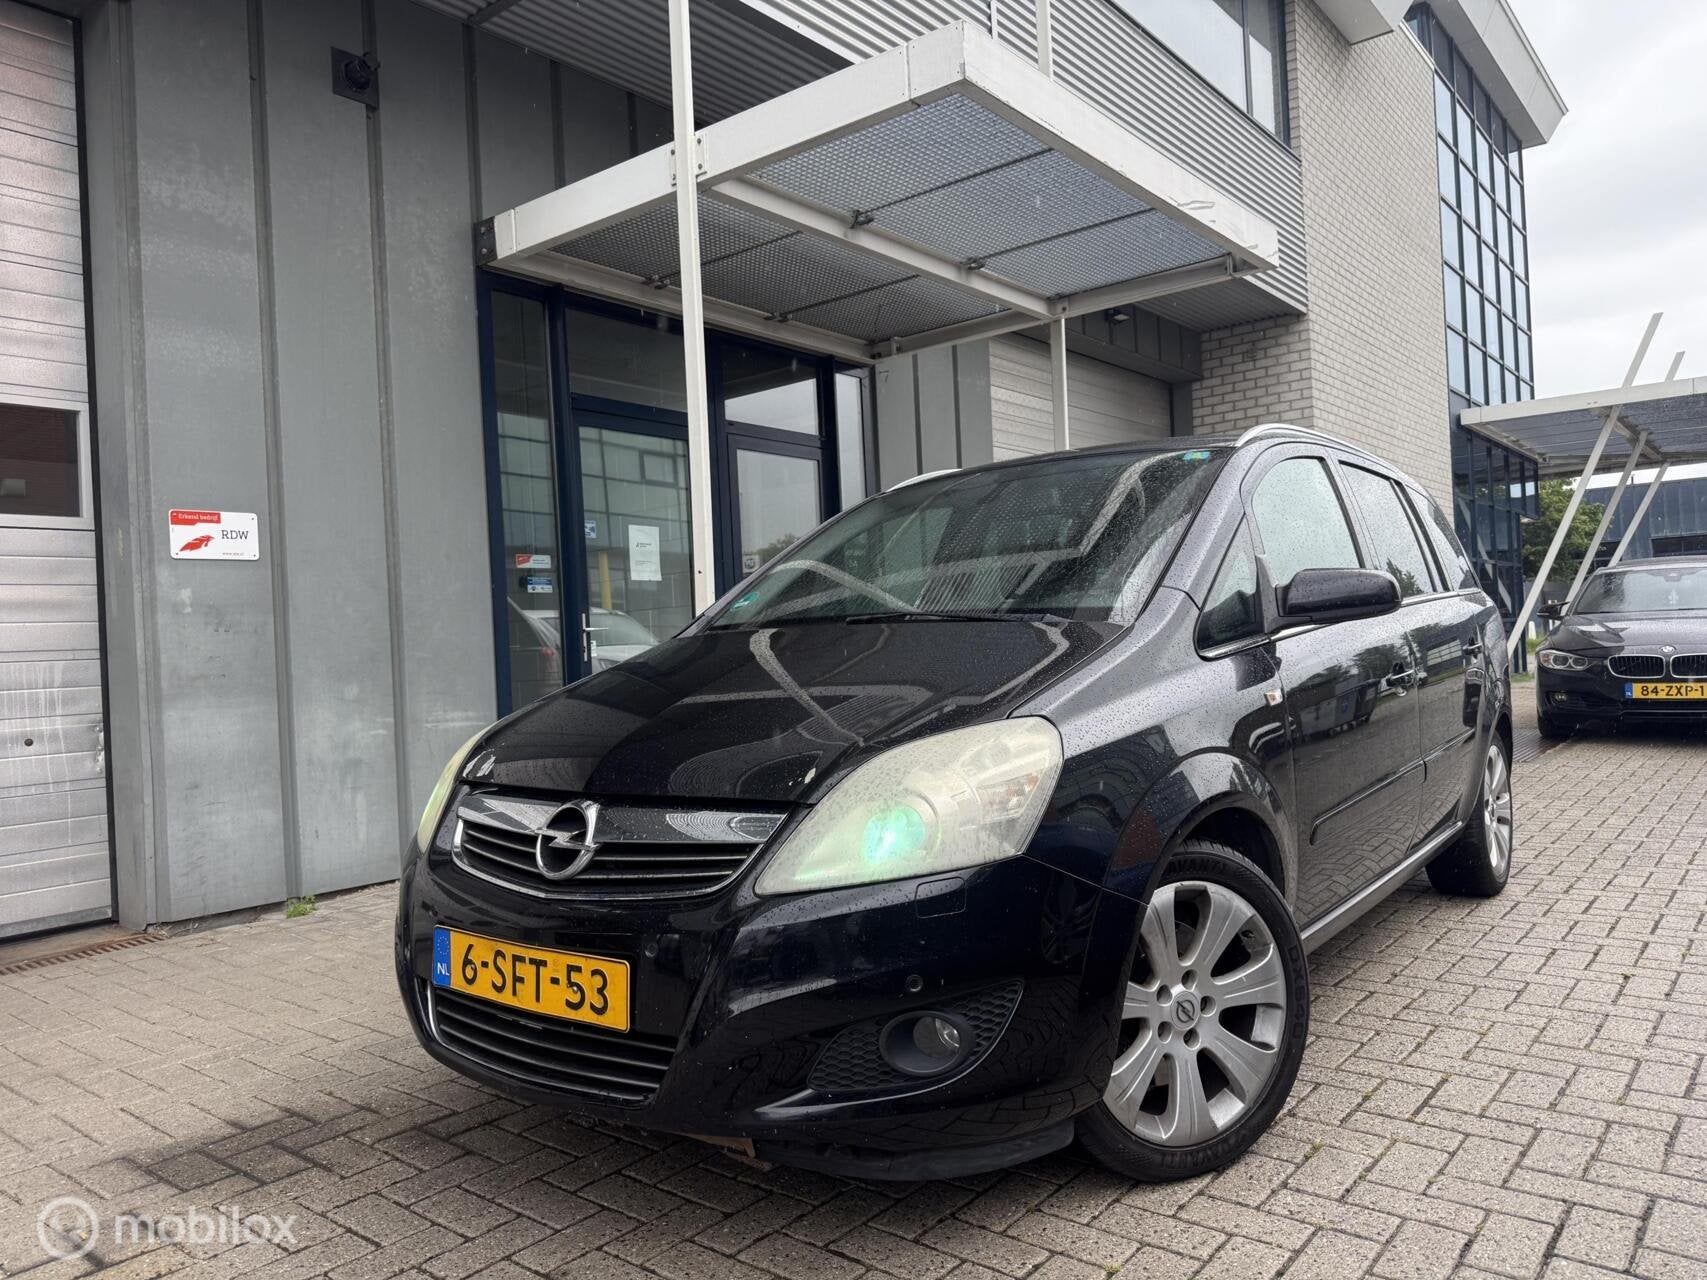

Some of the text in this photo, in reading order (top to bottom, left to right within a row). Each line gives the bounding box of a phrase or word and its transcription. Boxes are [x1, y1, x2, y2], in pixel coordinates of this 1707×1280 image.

[221, 529, 249, 540] RDW
[1640, 685, 1705, 697] 84-ZXP-1
[437, 961, 450, 976] NL
[461, 943, 609, 1016] 6-SFT-53
